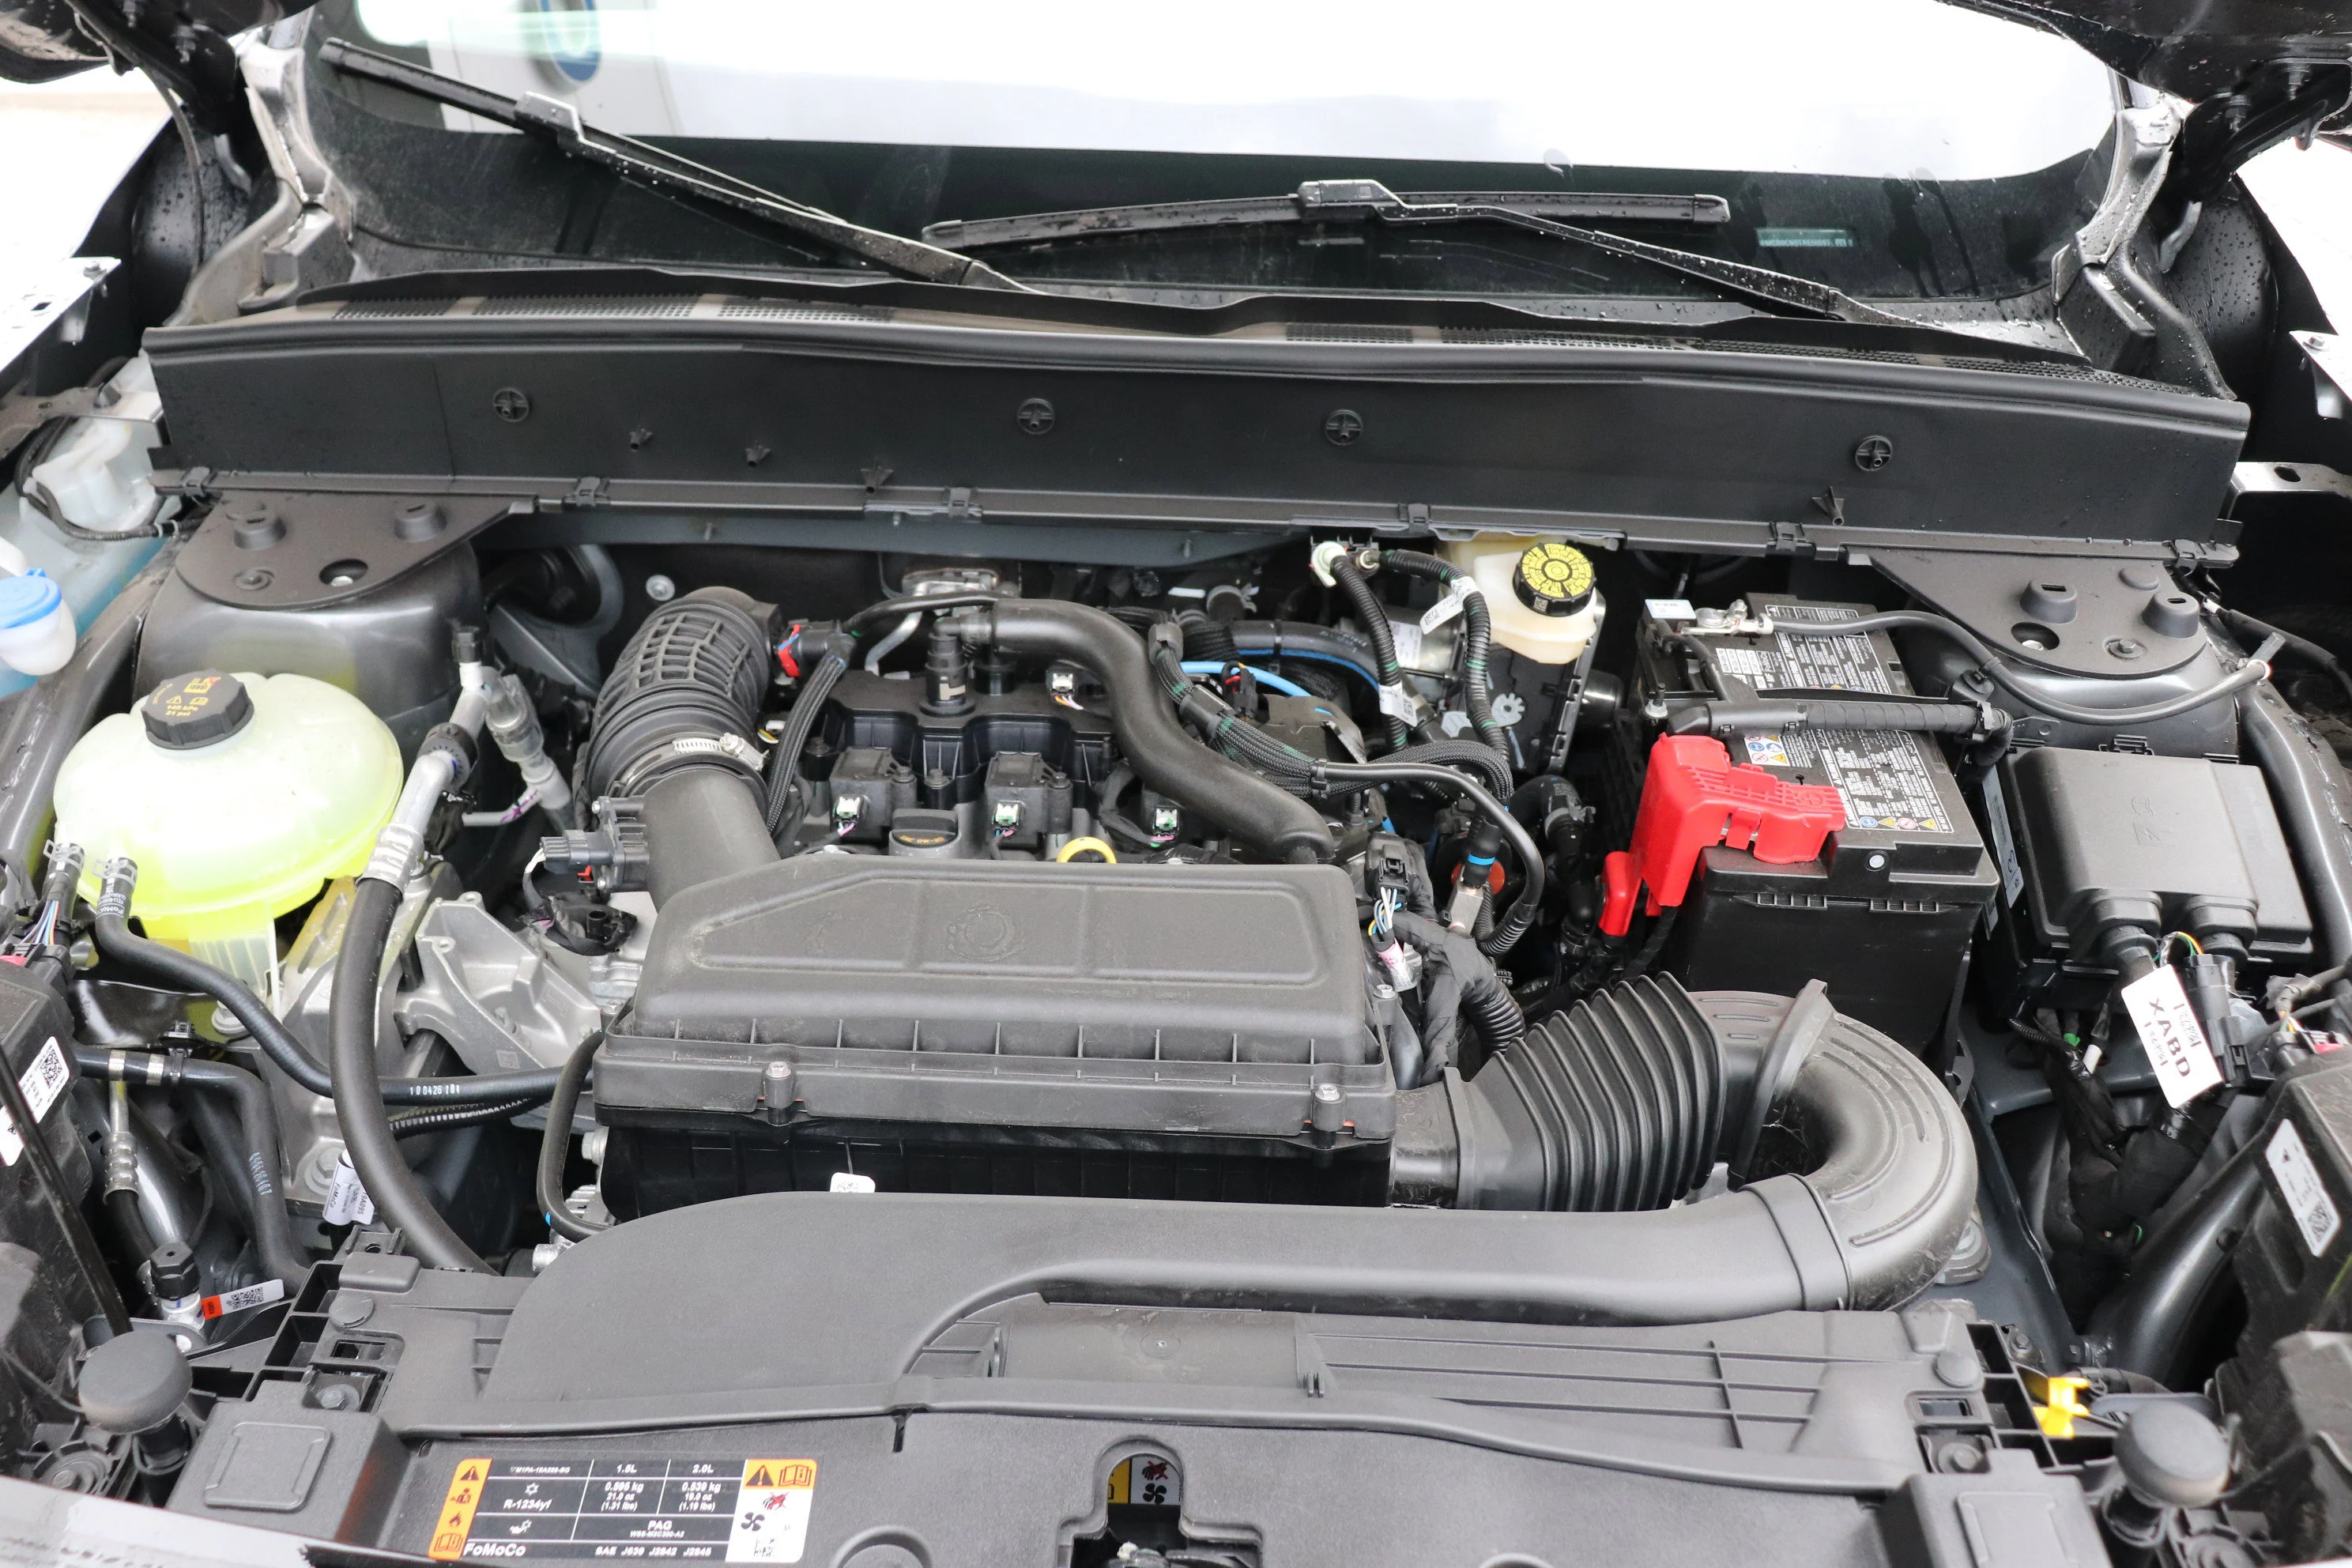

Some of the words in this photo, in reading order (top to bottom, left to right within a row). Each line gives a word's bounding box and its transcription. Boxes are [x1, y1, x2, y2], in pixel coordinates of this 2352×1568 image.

[97, 906, 123, 915] FoMoC
[2148, 998, 2191, 1077] XABD
[330, 1182, 341, 1208] FoMoCo
[616, 1464, 638, 1474] 1.5L
[692, 1464, 714, 1474] 2.0L
[631, 1482, 644, 1494] kg
[709, 1482, 722, 1494] kg
[606, 1492, 624, 1501] 21.0
[503, 1499, 553, 1512] R-1234yf
[622, 1502, 638, 1512] lbs)
[699, 1502, 716, 1513] lbs)
[647, 1521, 673, 1530] PAG
[462, 1543, 526, 1557] FoMoCo
[594, 1546, 617, 1556] SAE
